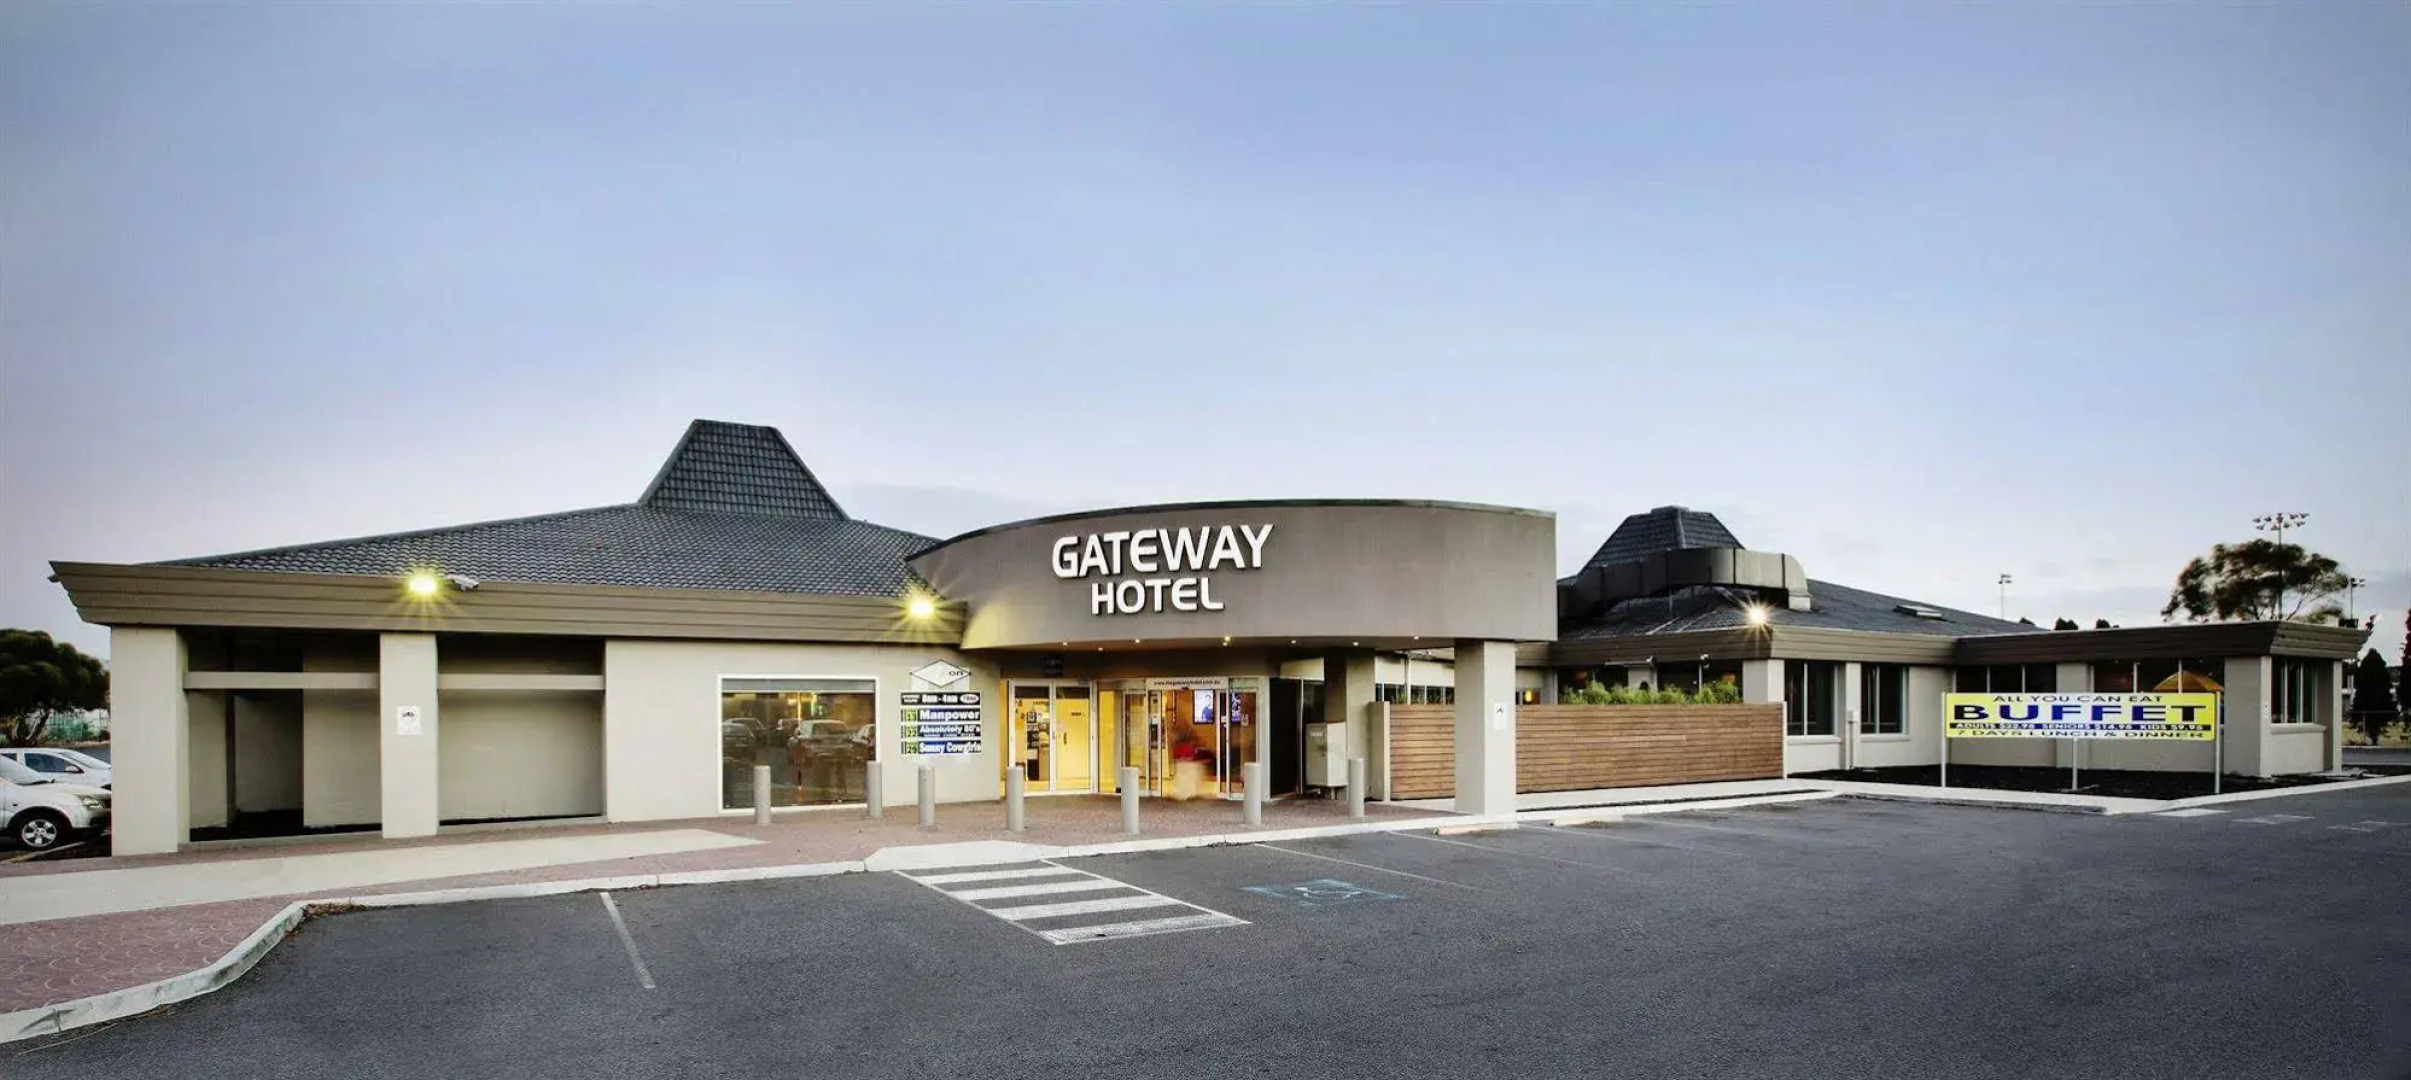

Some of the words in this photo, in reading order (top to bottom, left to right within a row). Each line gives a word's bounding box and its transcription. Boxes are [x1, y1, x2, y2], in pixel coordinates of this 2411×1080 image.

[1051, 523, 1274, 579] GATEWAY
[1091, 577, 1225, 615] HOTEL
[920, 710, 980, 721] Manpower
[1953, 704, 2207, 721] BUFFET
[920, 726, 963, 734] Absolutely
